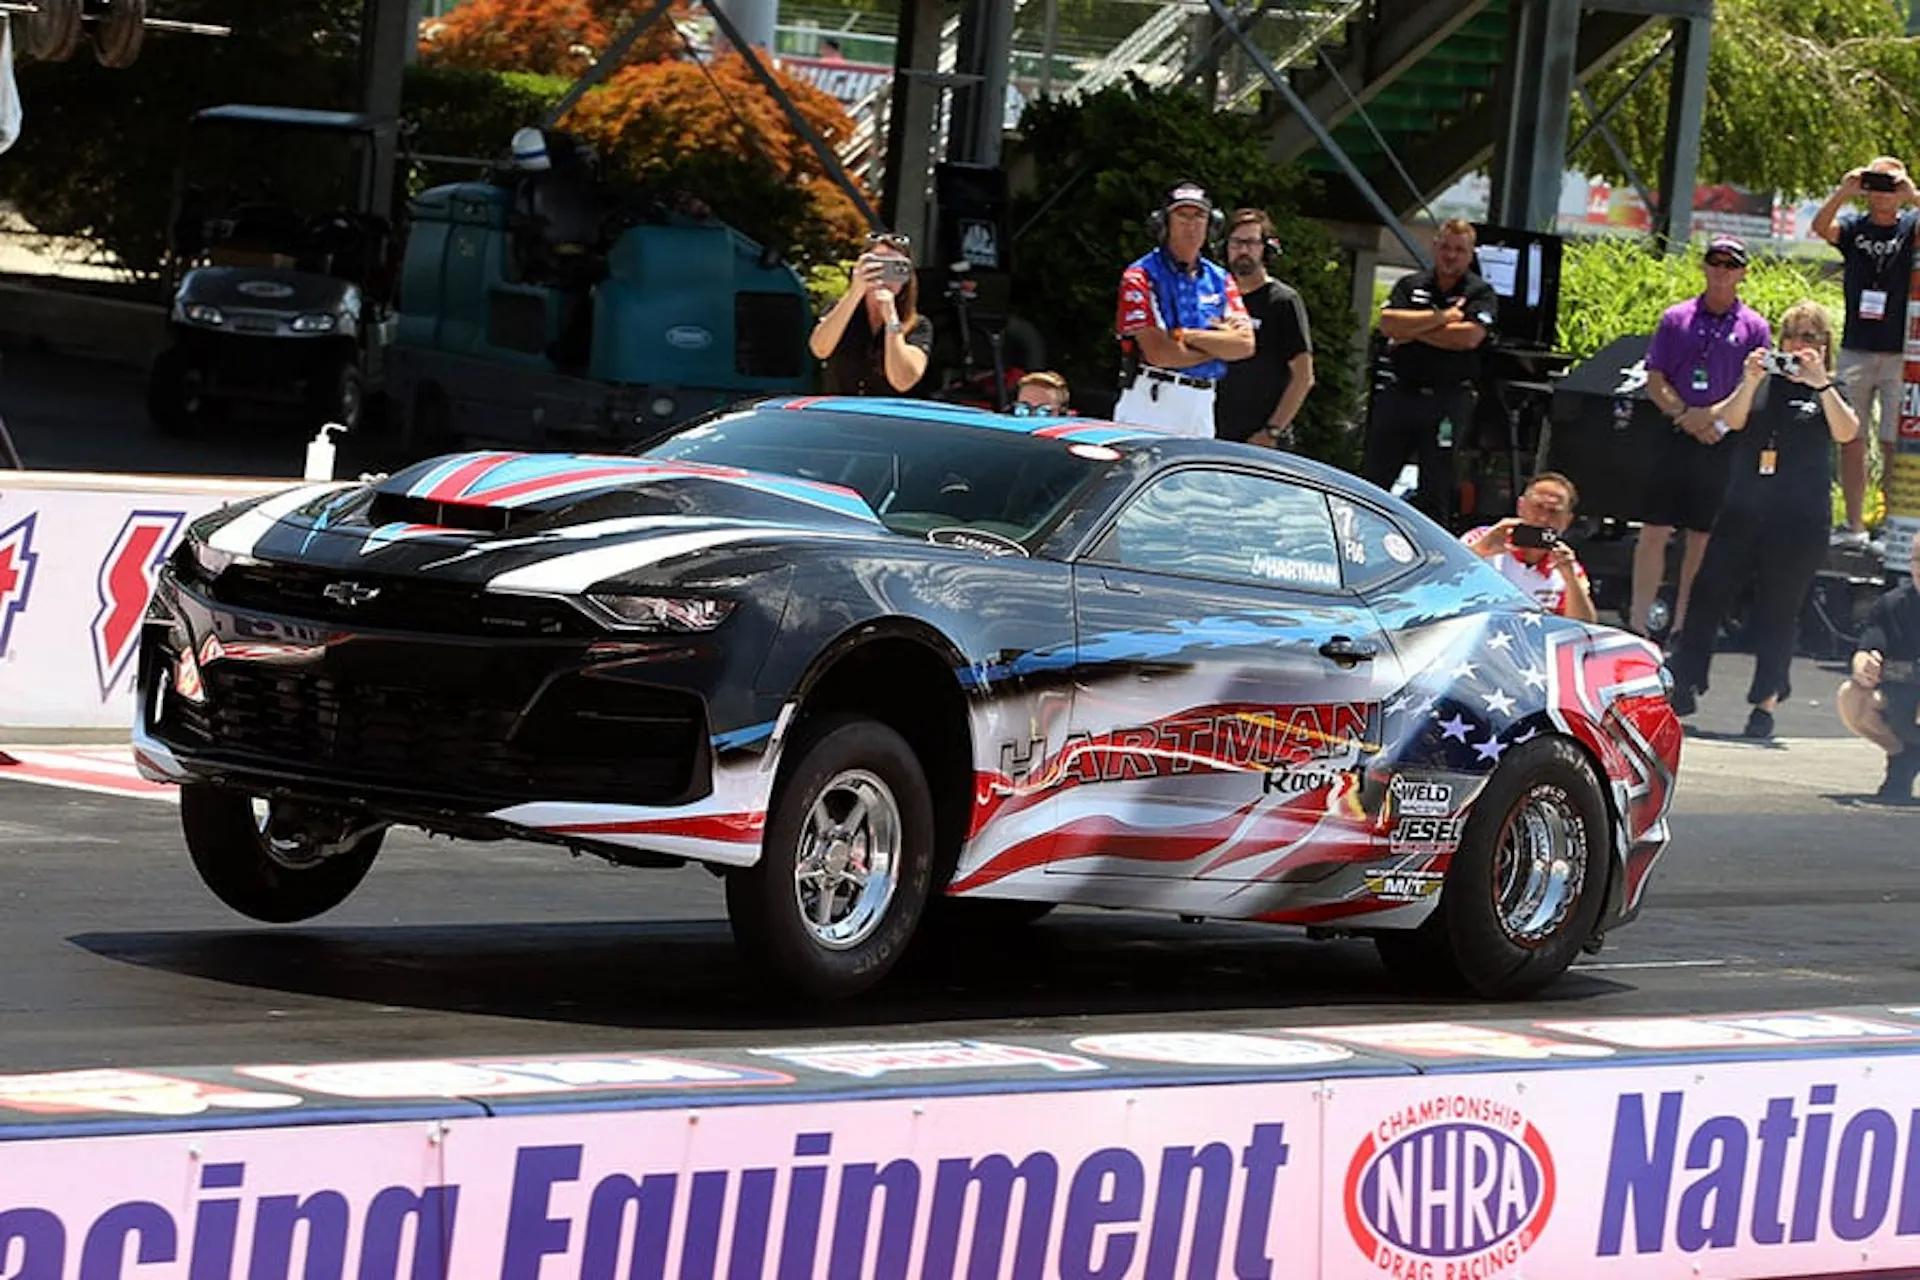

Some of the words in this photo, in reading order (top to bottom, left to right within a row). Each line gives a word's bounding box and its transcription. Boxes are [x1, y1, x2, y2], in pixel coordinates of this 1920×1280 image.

[1267, 556, 1338, 583] HARTMAN
[998, 700, 1384, 793] HARTMAN
[1401, 783, 1449, 801] WELD
[1378, 1096, 1522, 1142] CHAMPIONSHIP
[1376, 1129, 1529, 1251] NHRA
[1378, 1247, 1434, 1280] DRAG
[1445, 1240, 1518, 1280] RACING
